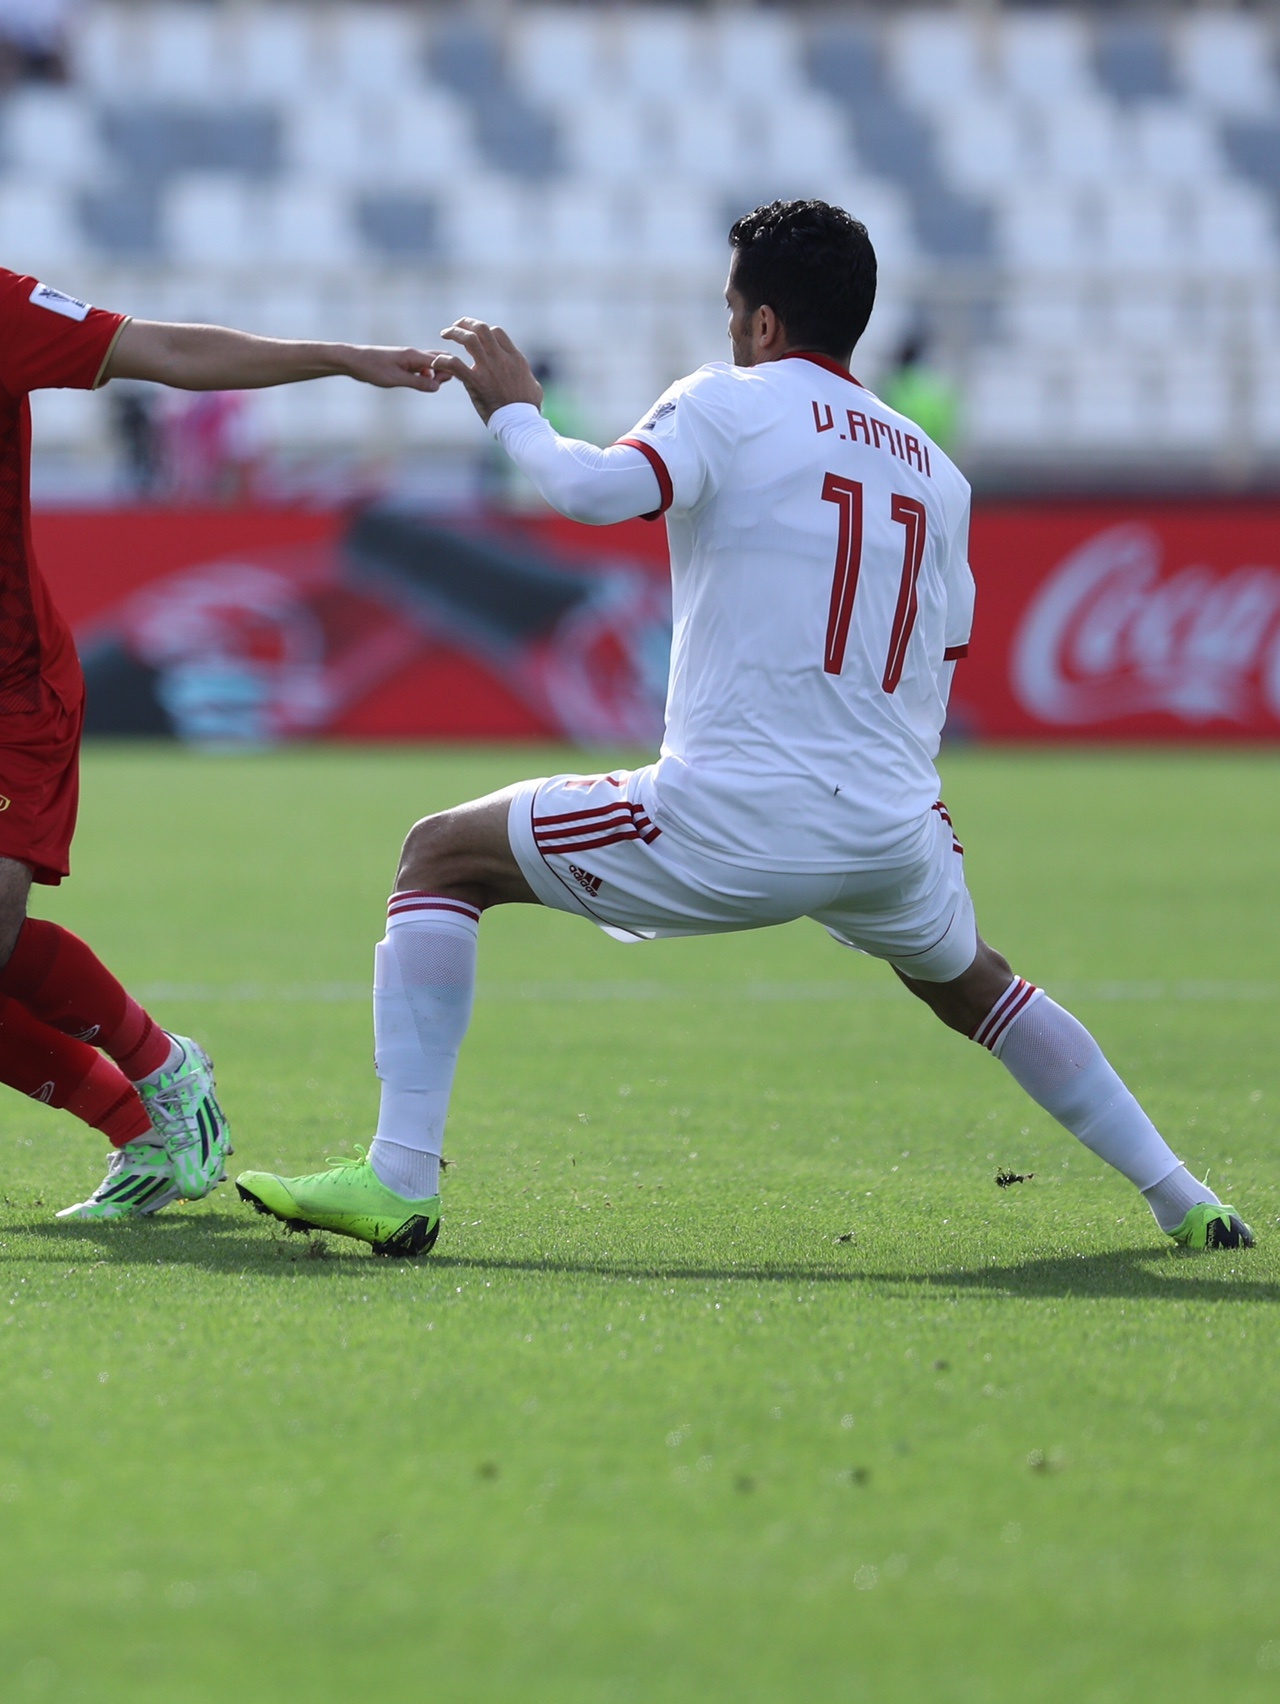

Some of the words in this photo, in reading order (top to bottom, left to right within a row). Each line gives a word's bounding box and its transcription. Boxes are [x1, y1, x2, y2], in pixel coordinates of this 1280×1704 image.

[811, 400, 932, 479] V.AMIRI
[821, 471, 927, 695] 11
[568, 864, 598, 898] adidas
